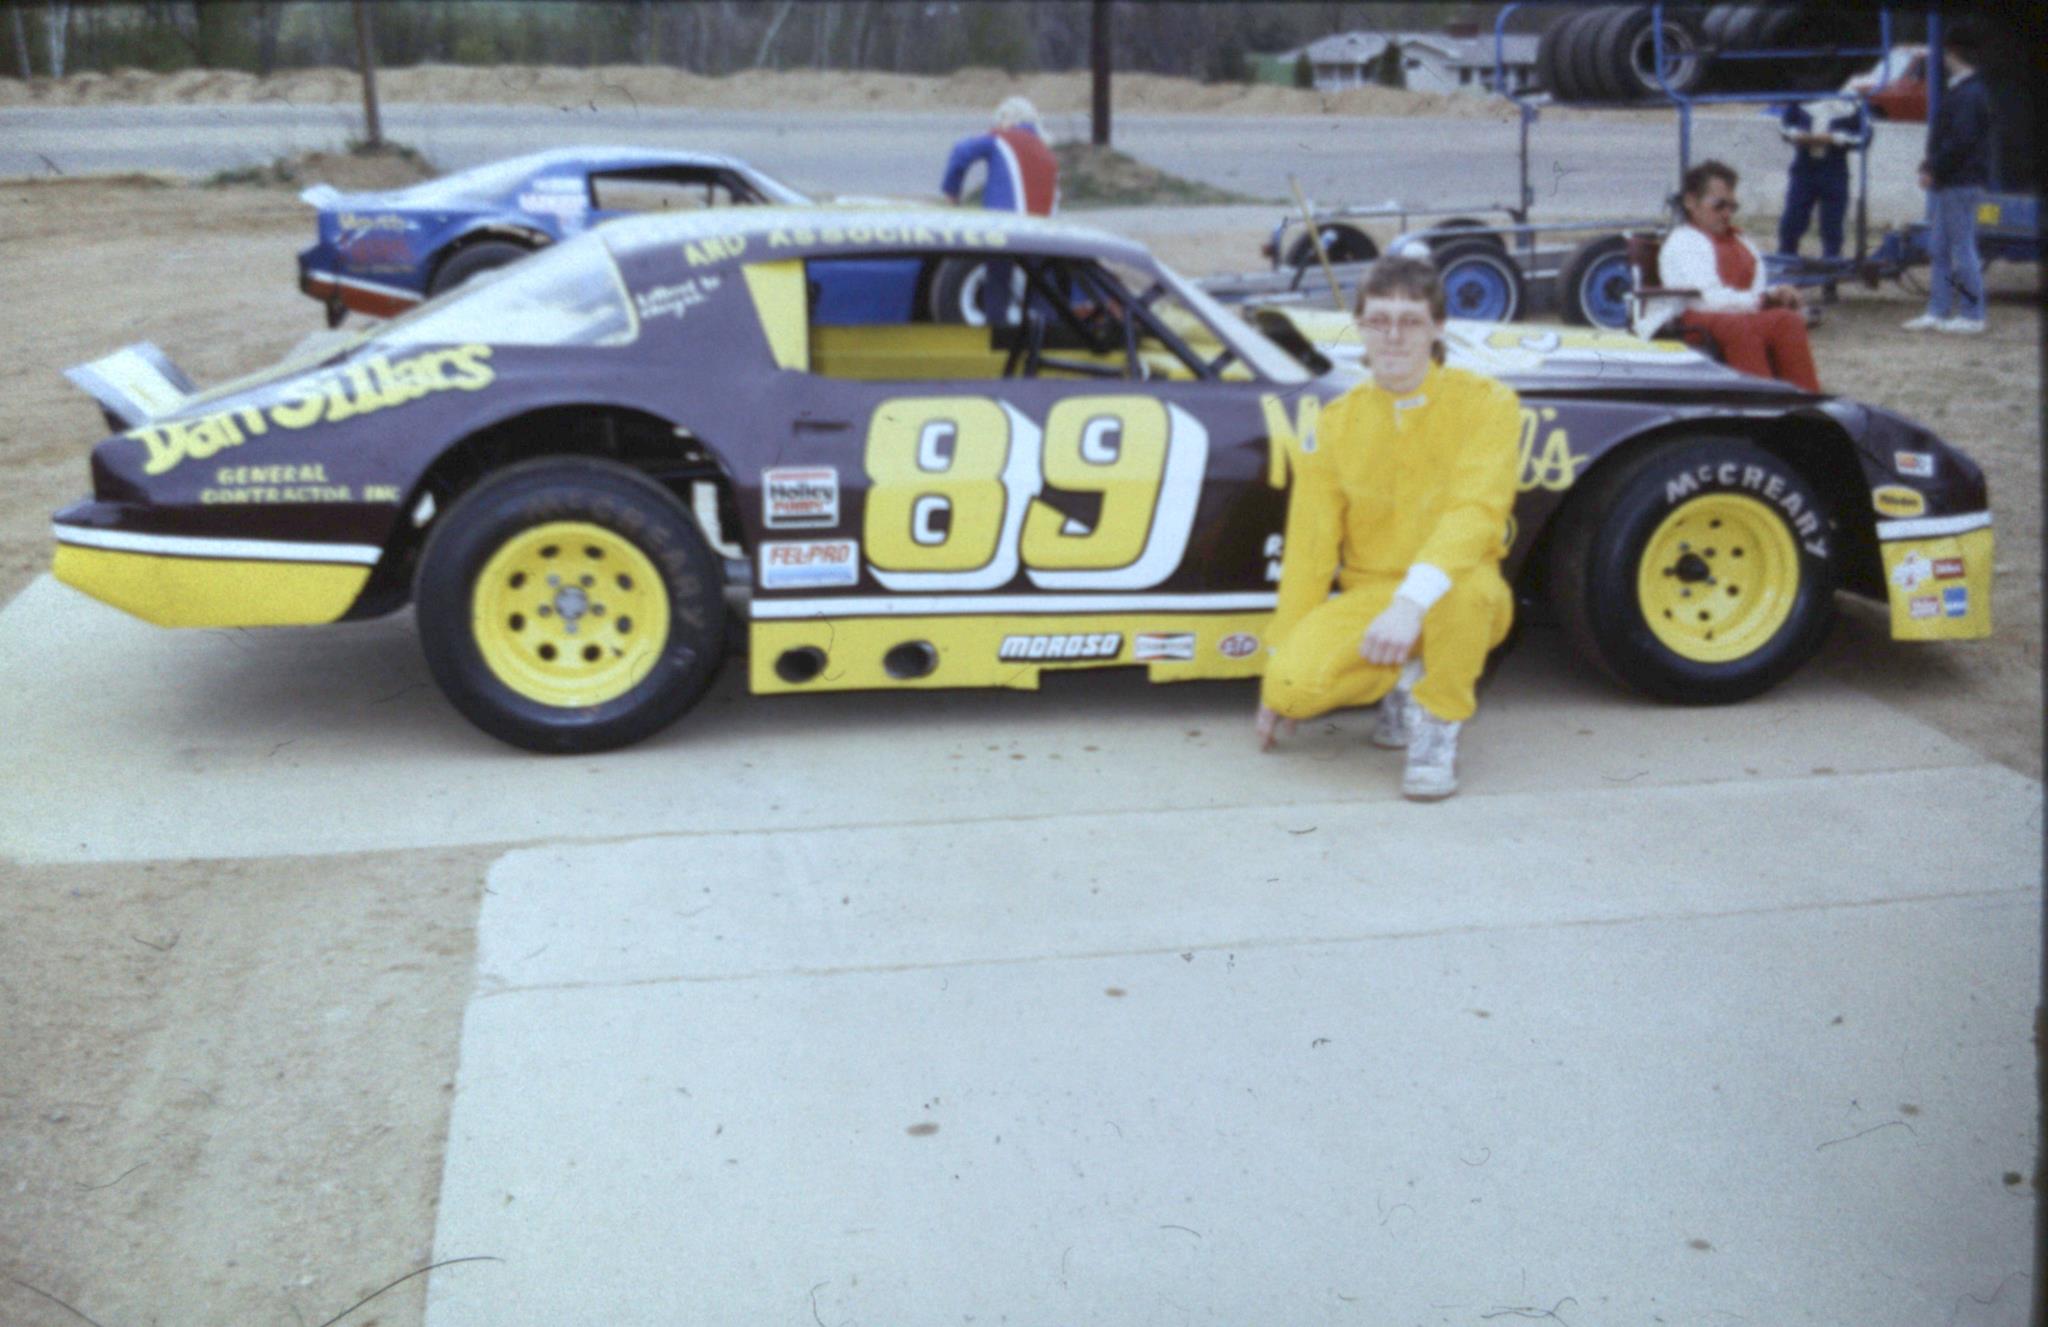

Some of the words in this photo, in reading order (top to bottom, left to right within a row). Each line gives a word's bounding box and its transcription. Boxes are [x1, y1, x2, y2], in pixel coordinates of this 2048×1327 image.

[683, 236, 747, 267] AND
[767, 227, 1007, 248] ASSOCIATES
[132, 408, 268, 476] Dan
[217, 463, 329, 486] GENERAL
[864, 394, 1209, 591] 89
[998, 632, 1122, 661] MOROSO
